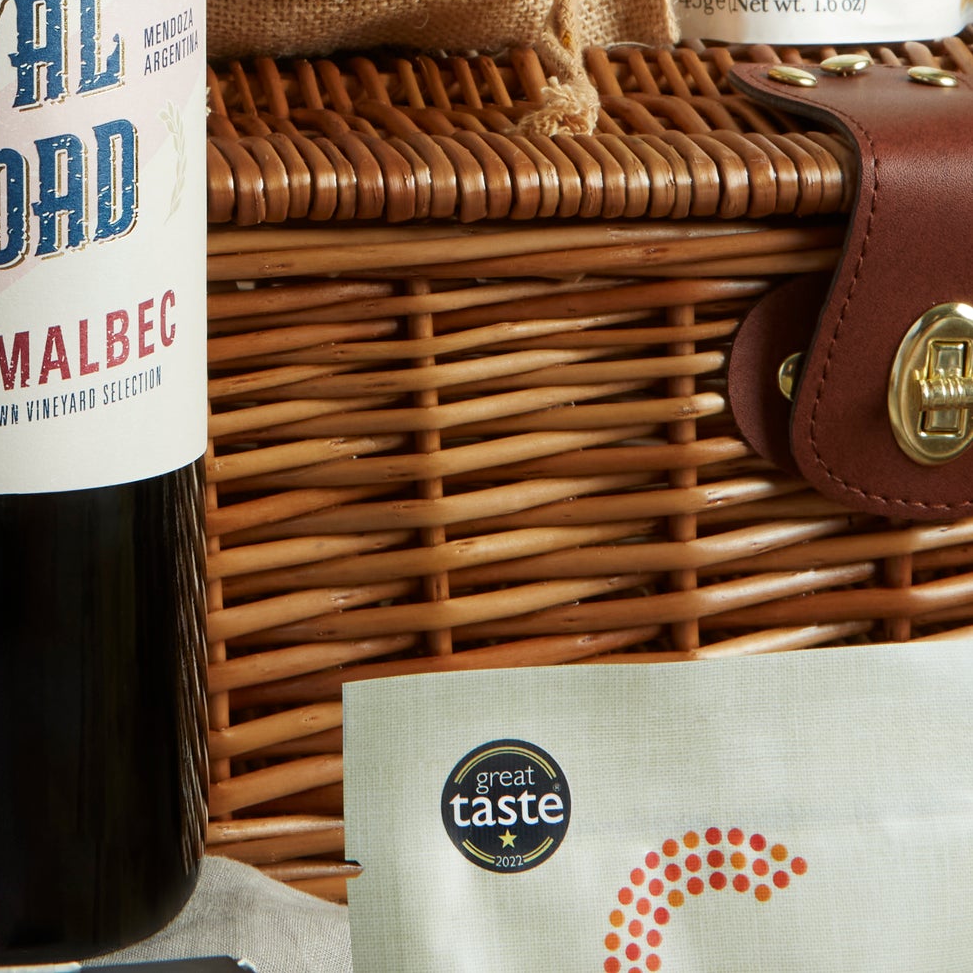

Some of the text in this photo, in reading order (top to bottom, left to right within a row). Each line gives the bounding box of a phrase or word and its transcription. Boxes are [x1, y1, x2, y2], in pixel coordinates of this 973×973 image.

[144, 7, 194, 49] MENDOZA
[143, 30, 199, 76] ARGENTINA
[26, 388, 96, 423] VINEYARD
[103, 365, 162, 406] SELECTION
[475, 765, 535, 795] great
[449, 790, 564, 827] taste
[495, 854, 524, 868] 2022
